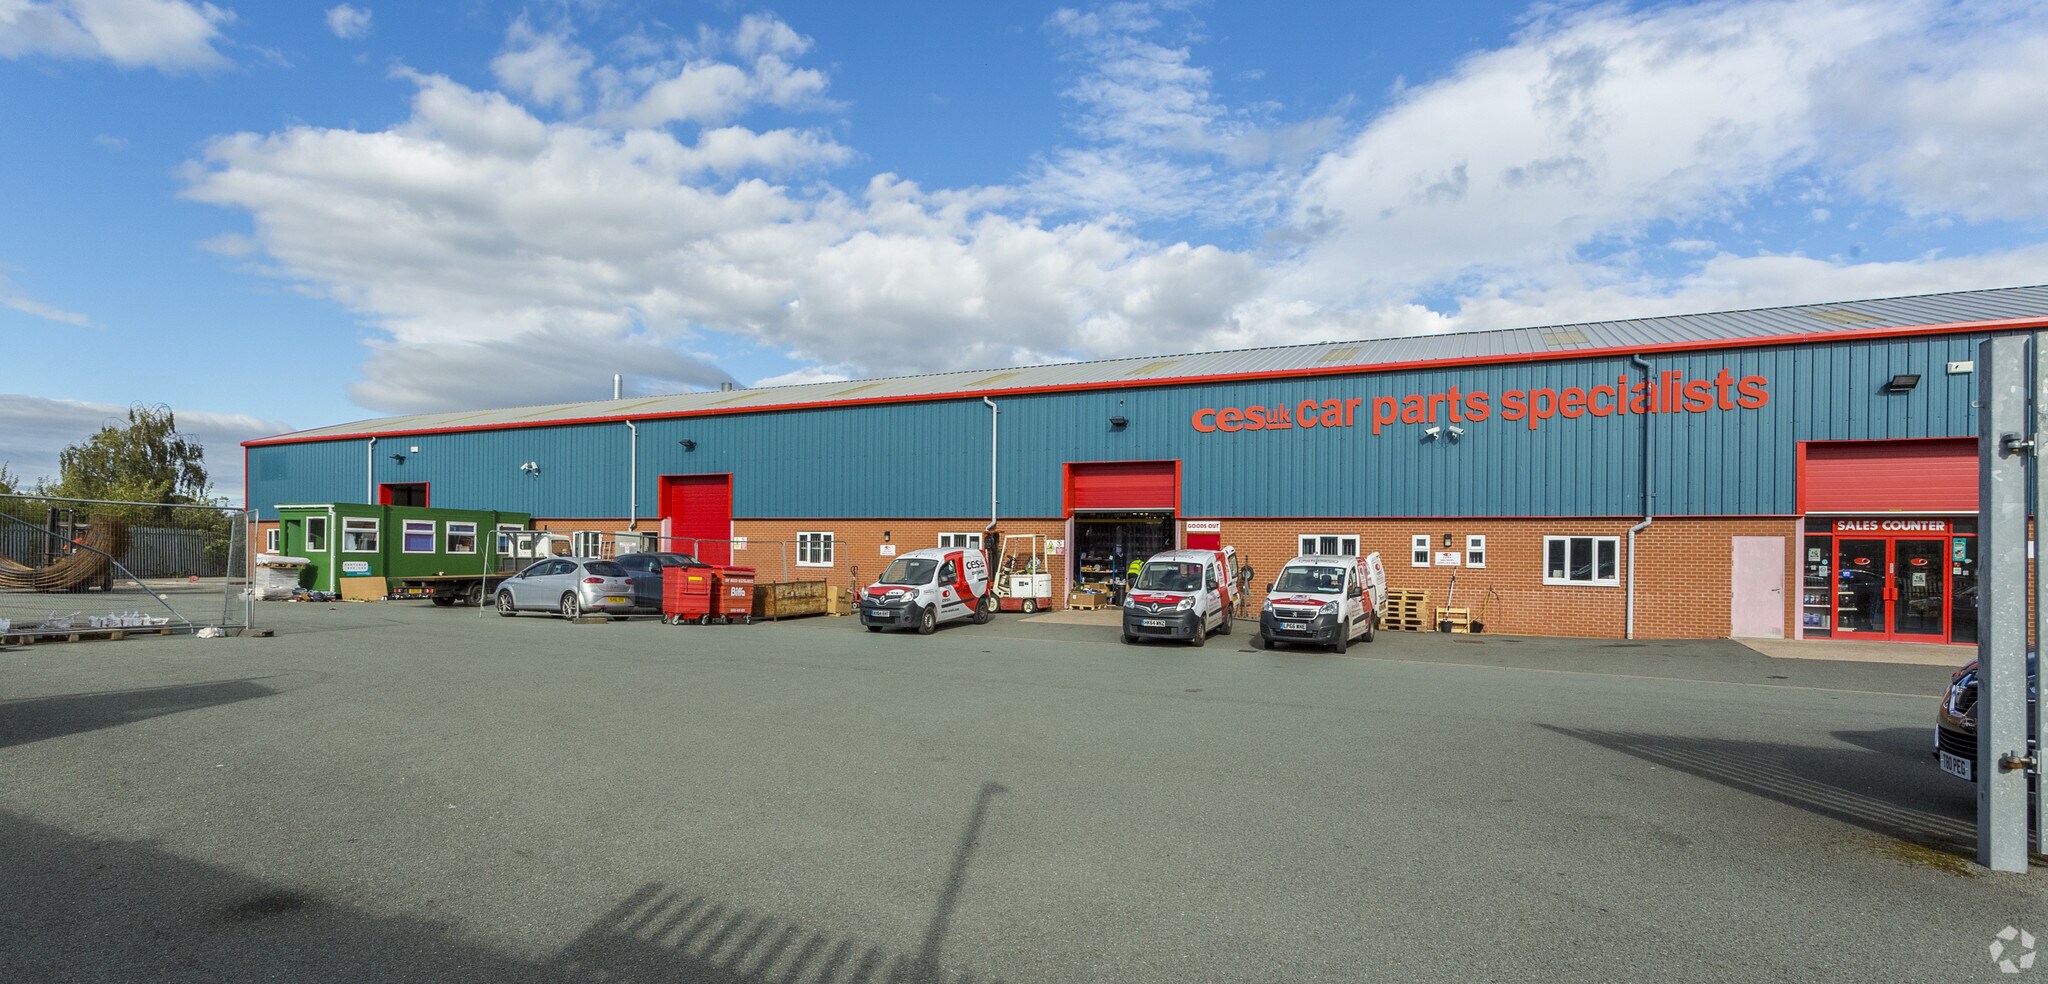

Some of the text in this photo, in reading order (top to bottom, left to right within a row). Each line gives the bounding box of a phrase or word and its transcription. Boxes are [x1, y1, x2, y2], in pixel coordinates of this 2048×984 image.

[1296, 397, 1362, 429] car
[1372, 385, 1491, 435] parts
[1501, 368, 1770, 430] specialists
[1837, 521, 1945, 531] SALES COUNTER
[1953, 757, 1966, 776] PEG
